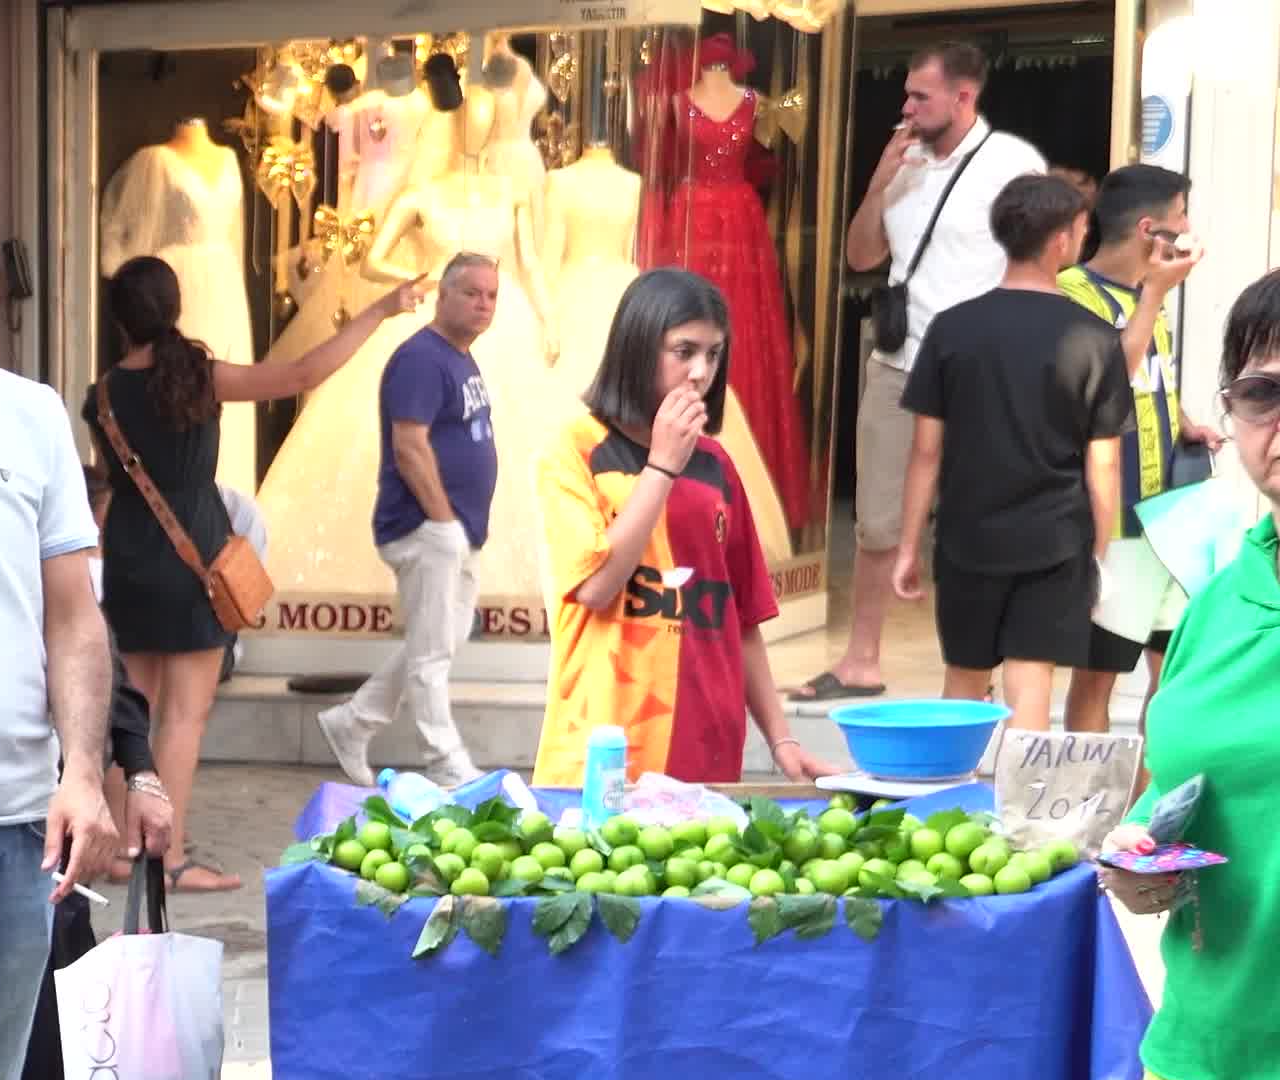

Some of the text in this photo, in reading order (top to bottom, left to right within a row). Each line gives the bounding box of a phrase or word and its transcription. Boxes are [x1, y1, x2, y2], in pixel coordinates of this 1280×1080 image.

[784, 562, 822, 594] MODE
[278, 602, 394, 633] MODE
[481, 606, 533, 635] ES
